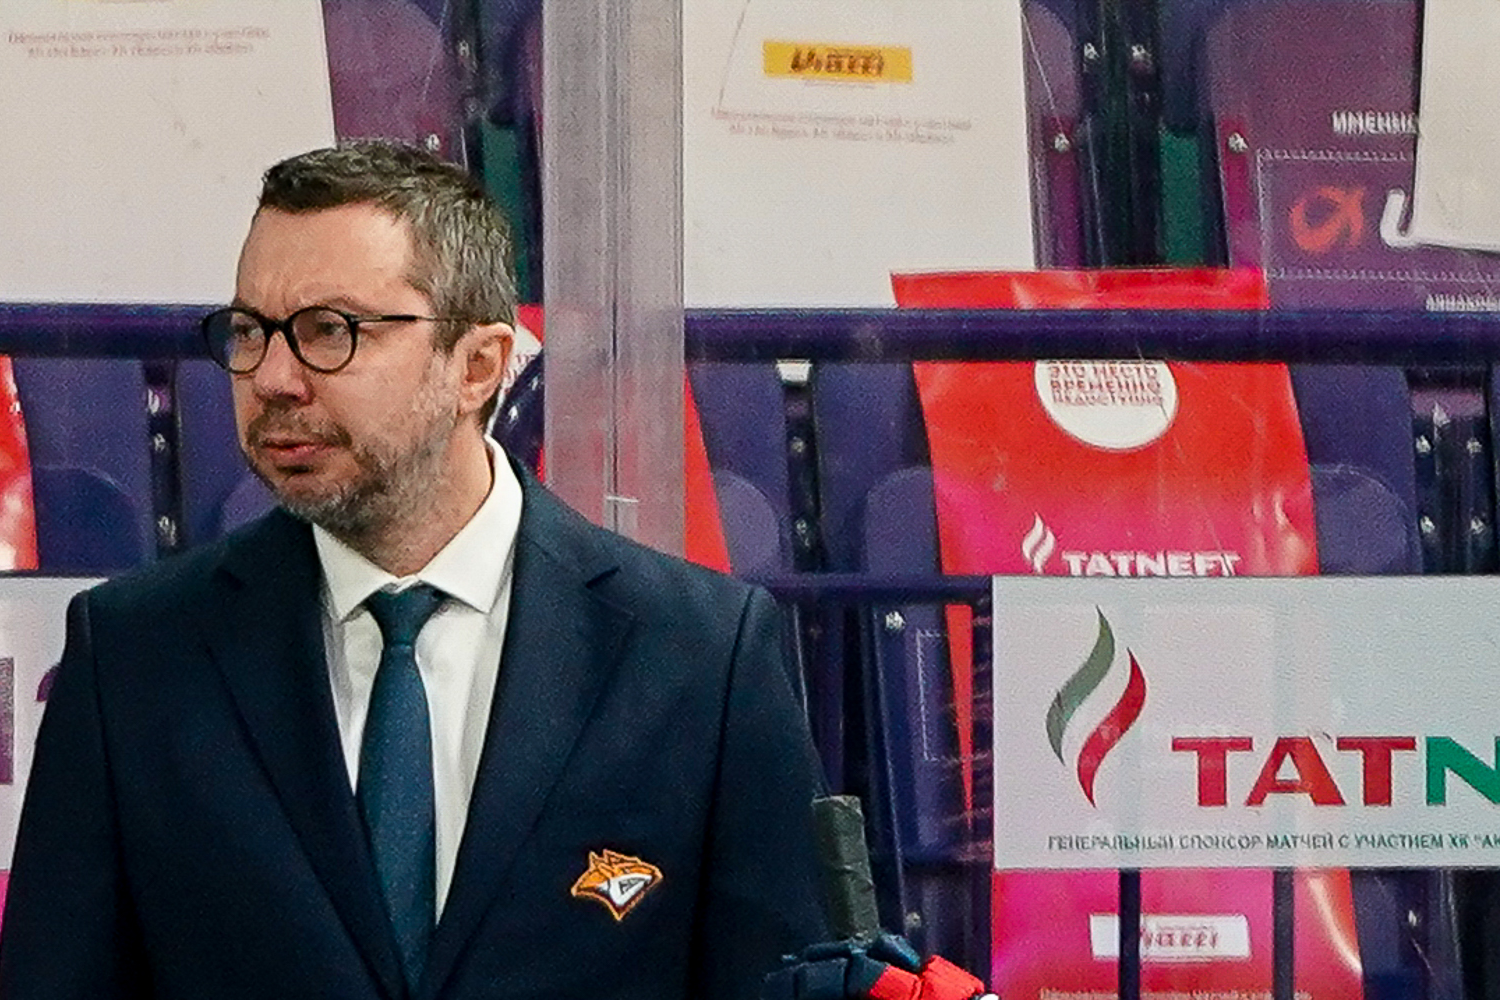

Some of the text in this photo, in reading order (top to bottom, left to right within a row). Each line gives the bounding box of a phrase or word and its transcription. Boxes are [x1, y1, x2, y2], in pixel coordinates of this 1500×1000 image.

[1061, 552, 1242, 576] TATNEFT
[1179, 833, 1265, 850] СПОНСОР
[1266, 832, 1334, 850] МАТЧЕЙ
[1338, 833, 1351, 850] С
[1354, 832, 1444, 850] УЧАСТИЕМ
